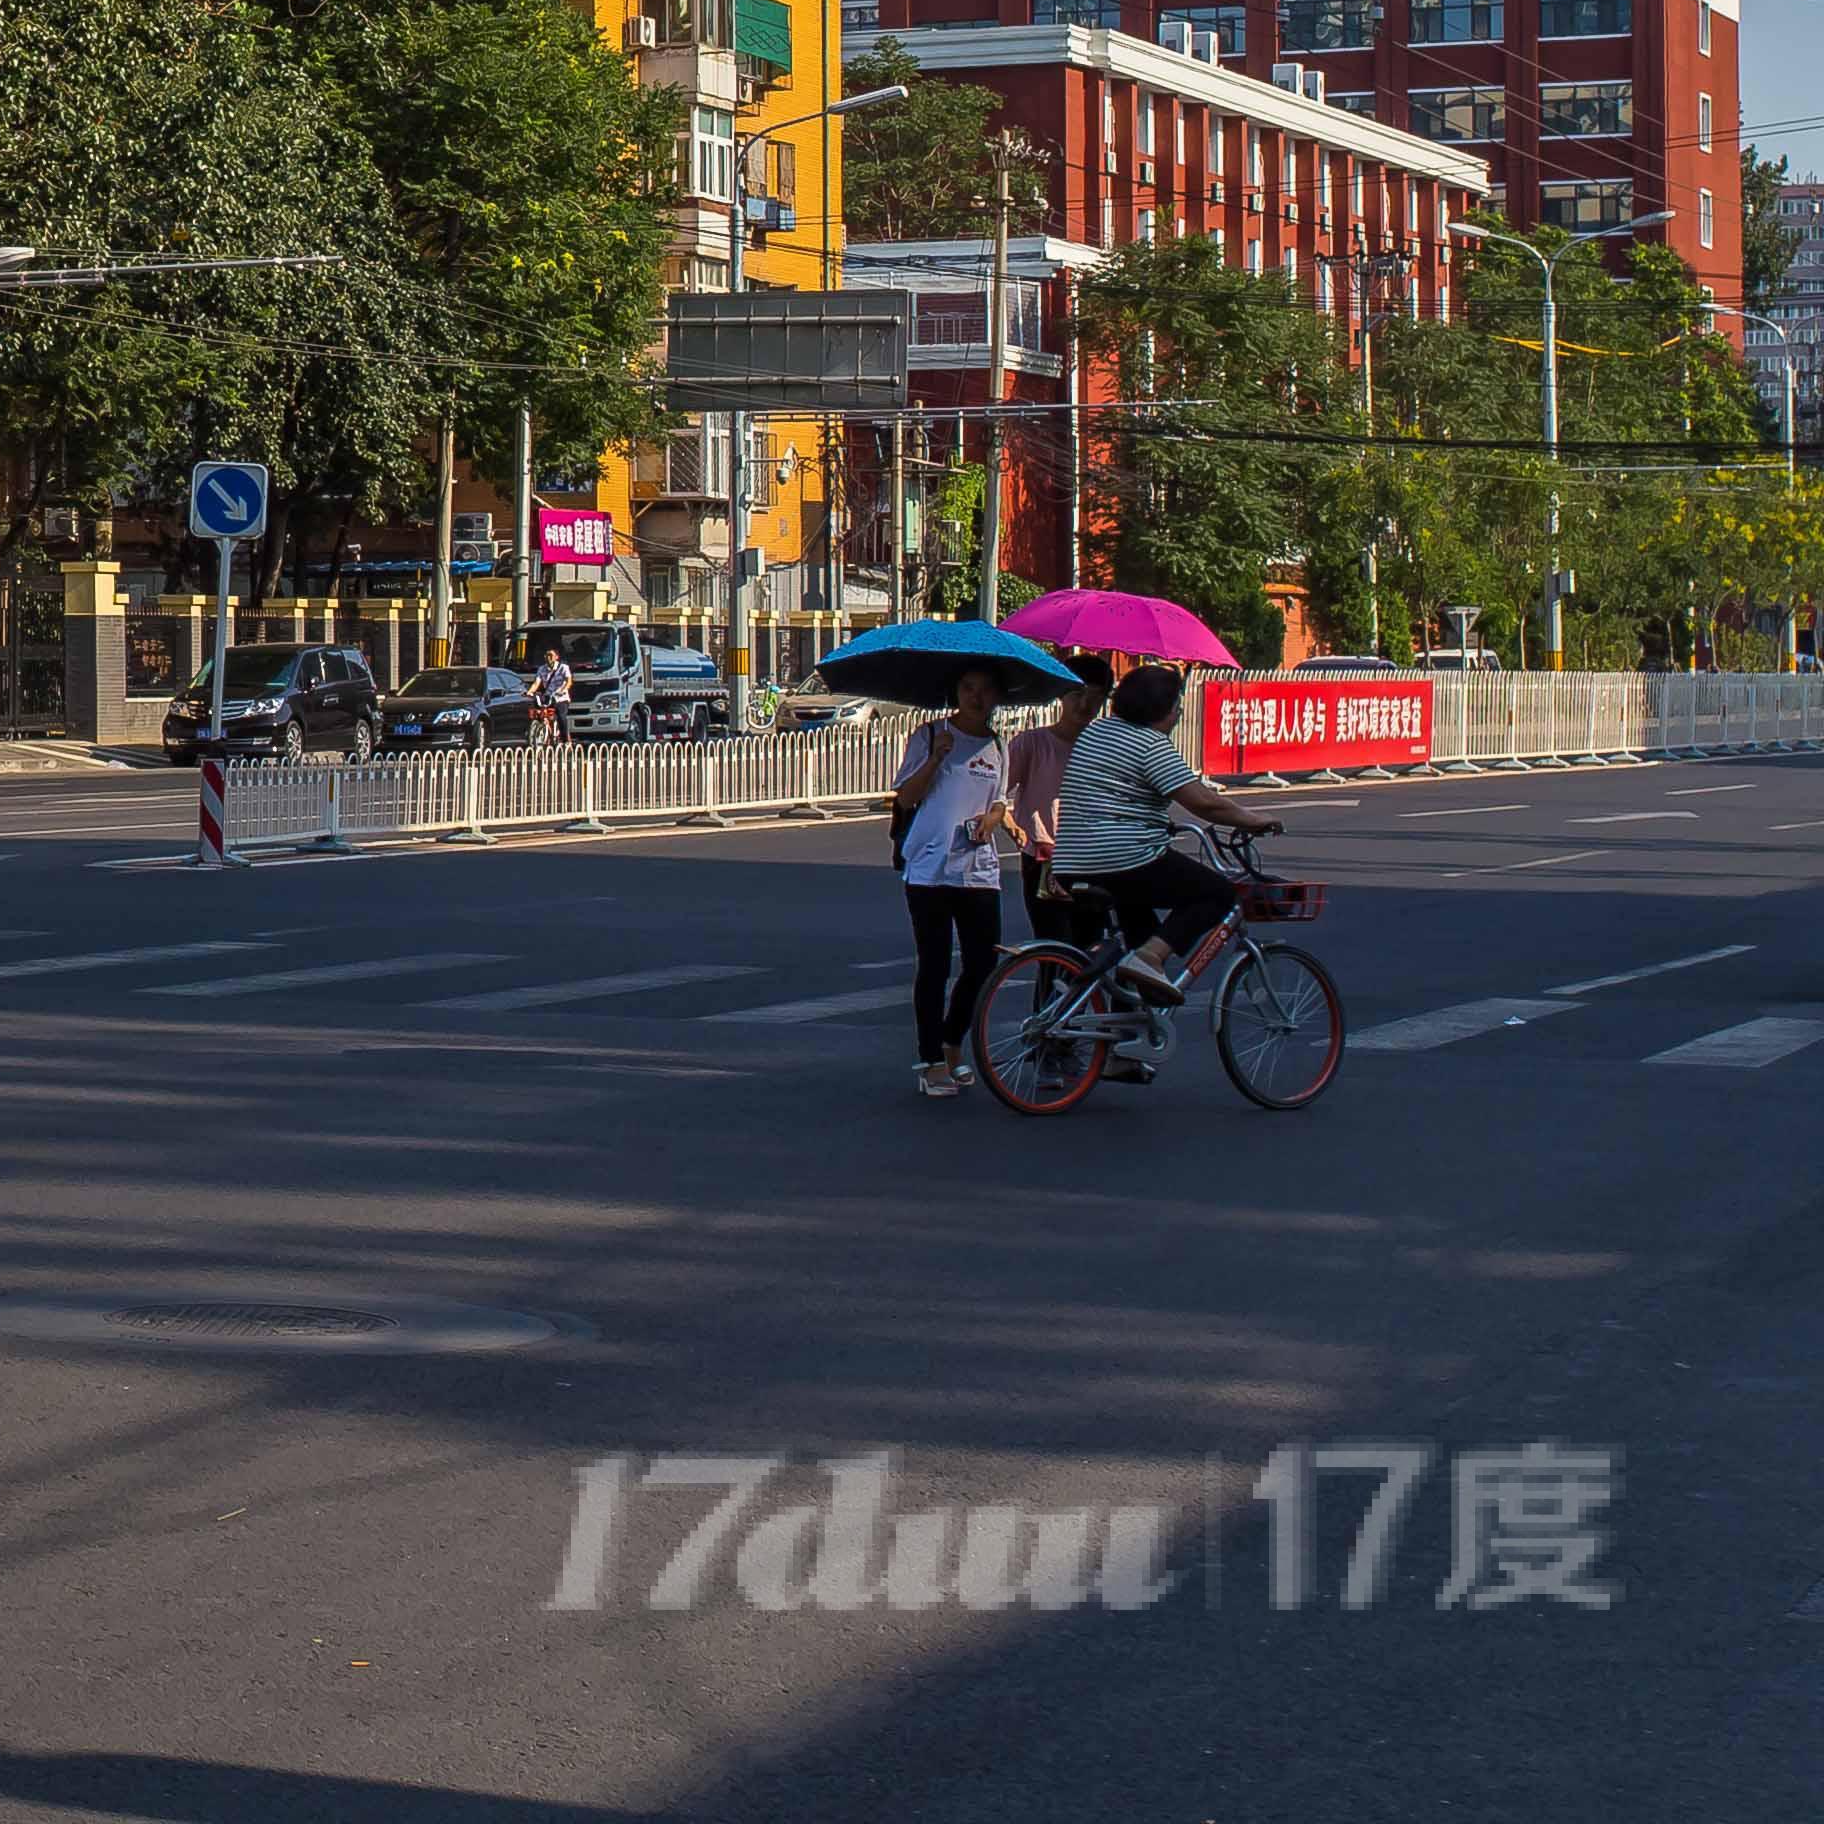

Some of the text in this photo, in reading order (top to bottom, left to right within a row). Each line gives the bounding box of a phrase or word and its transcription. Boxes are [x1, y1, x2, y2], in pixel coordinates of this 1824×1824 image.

[1220, 695, 1423, 747] 街巷治理人人参与 美好环境家家受益
